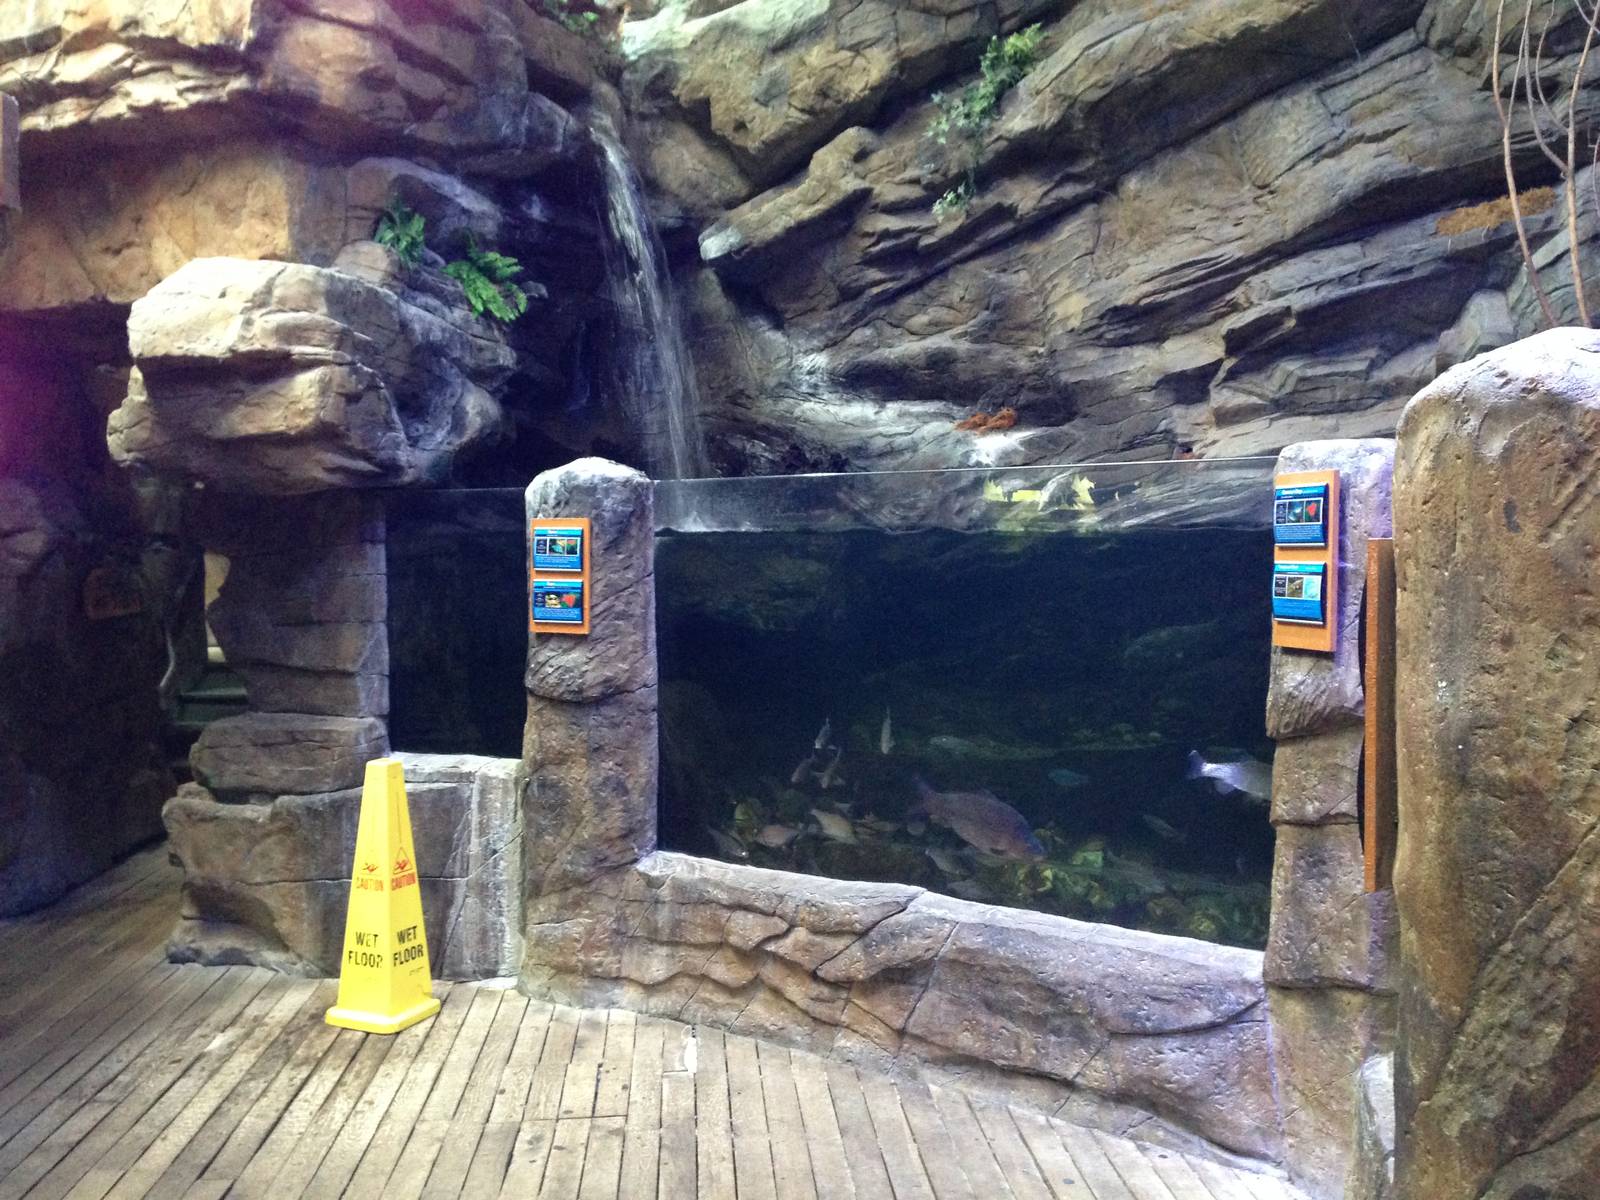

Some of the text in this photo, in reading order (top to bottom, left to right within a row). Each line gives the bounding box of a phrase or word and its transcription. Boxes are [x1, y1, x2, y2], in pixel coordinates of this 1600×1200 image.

[391, 872, 416, 891] CAUTION
[355, 931, 379, 948] WET
[397, 925, 417, 944] WET
[392, 944, 424, 967] FLOOR
